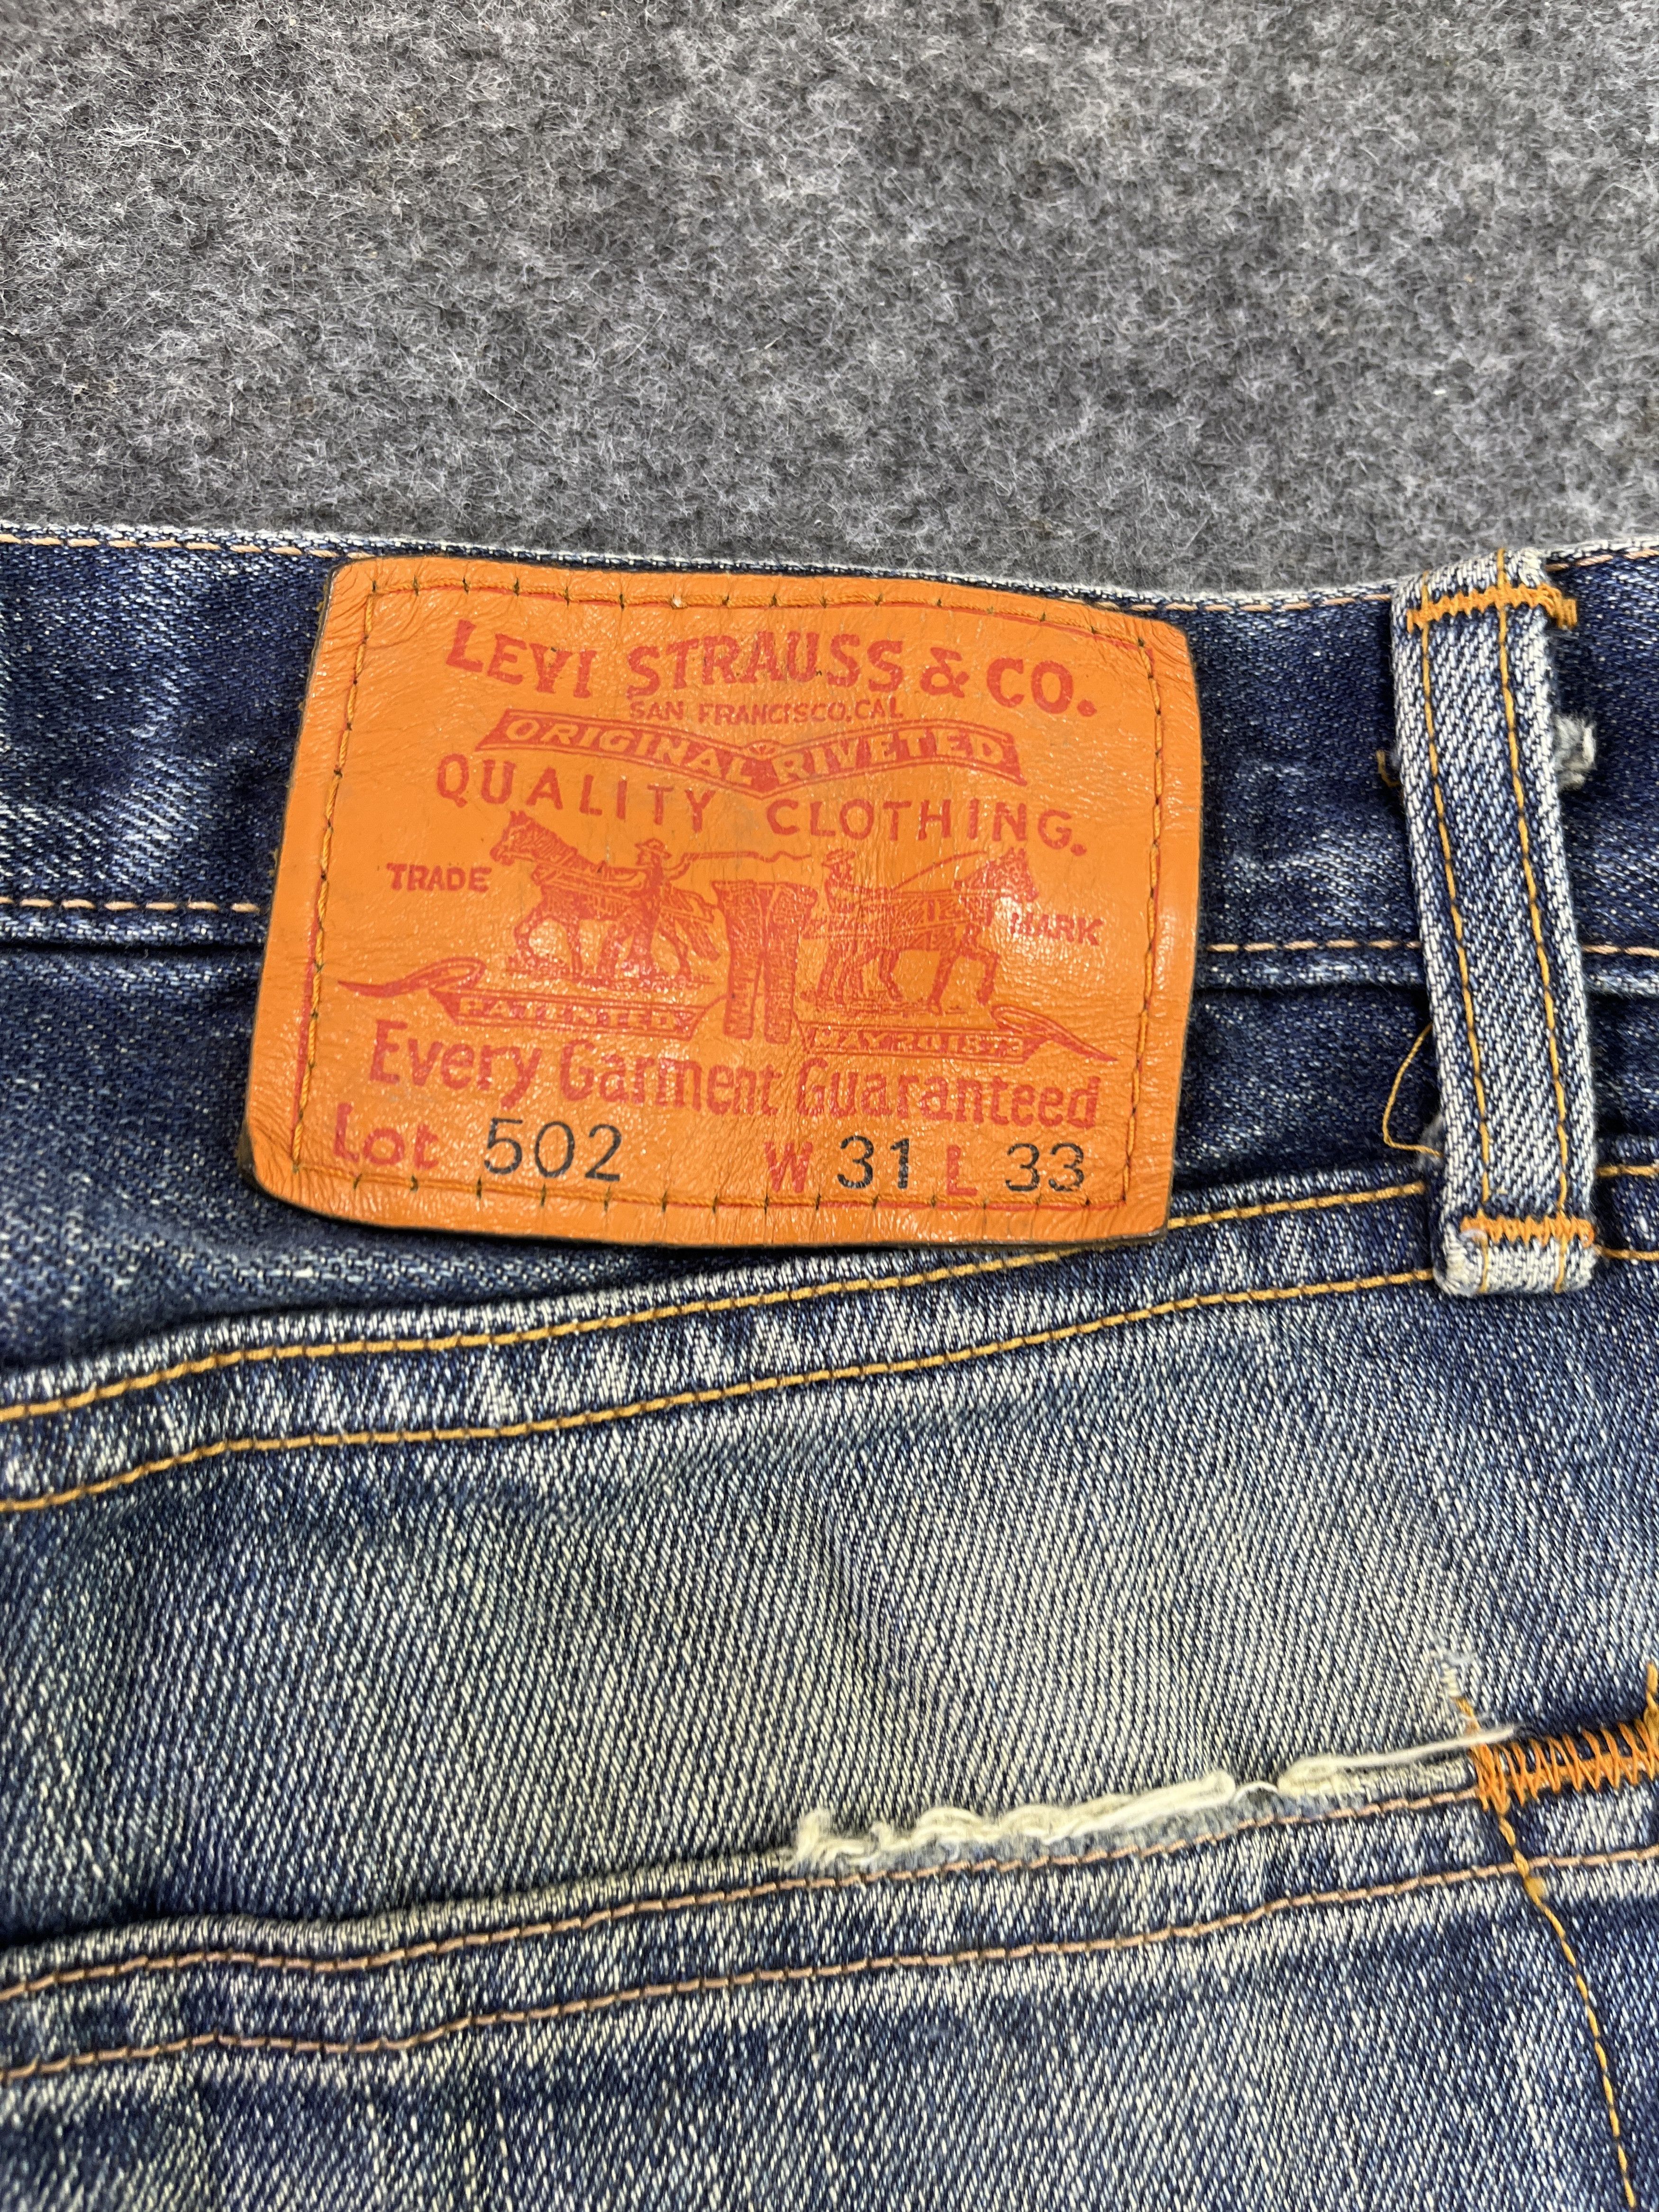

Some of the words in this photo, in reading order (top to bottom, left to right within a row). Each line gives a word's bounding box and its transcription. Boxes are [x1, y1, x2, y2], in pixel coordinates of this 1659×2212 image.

[446, 619, 598, 699] LEVI
[626, 630, 903, 699] STRAUSS
[920, 646, 970, 698] &
[986, 657, 1097, 717] CO.
[505, 717, 755, 785] ORIGINAL
[775, 728, 1004, 783] RIVETED
[629, 701, 684, 721] SAN
[436, 753, 716, 834] QUALITY
[766, 798, 1087, 855] CLOTHING.
[386, 862, 492, 893] TRADE
[458, 996, 677, 1031] PATENTED
[369, 1019, 543, 1110] Every
[559, 1039, 782, 1117] Garment
[796, 1057, 1102, 1130] Guaranteed
[332, 1101, 440, 1170] Lot
[483, 1117, 622, 1183] 502
[763, 1140, 814, 1194] W
[836, 1135, 911, 1190] 31
[948, 1144, 978, 1197] L
[1005, 1142, 1085, 1192] 33
